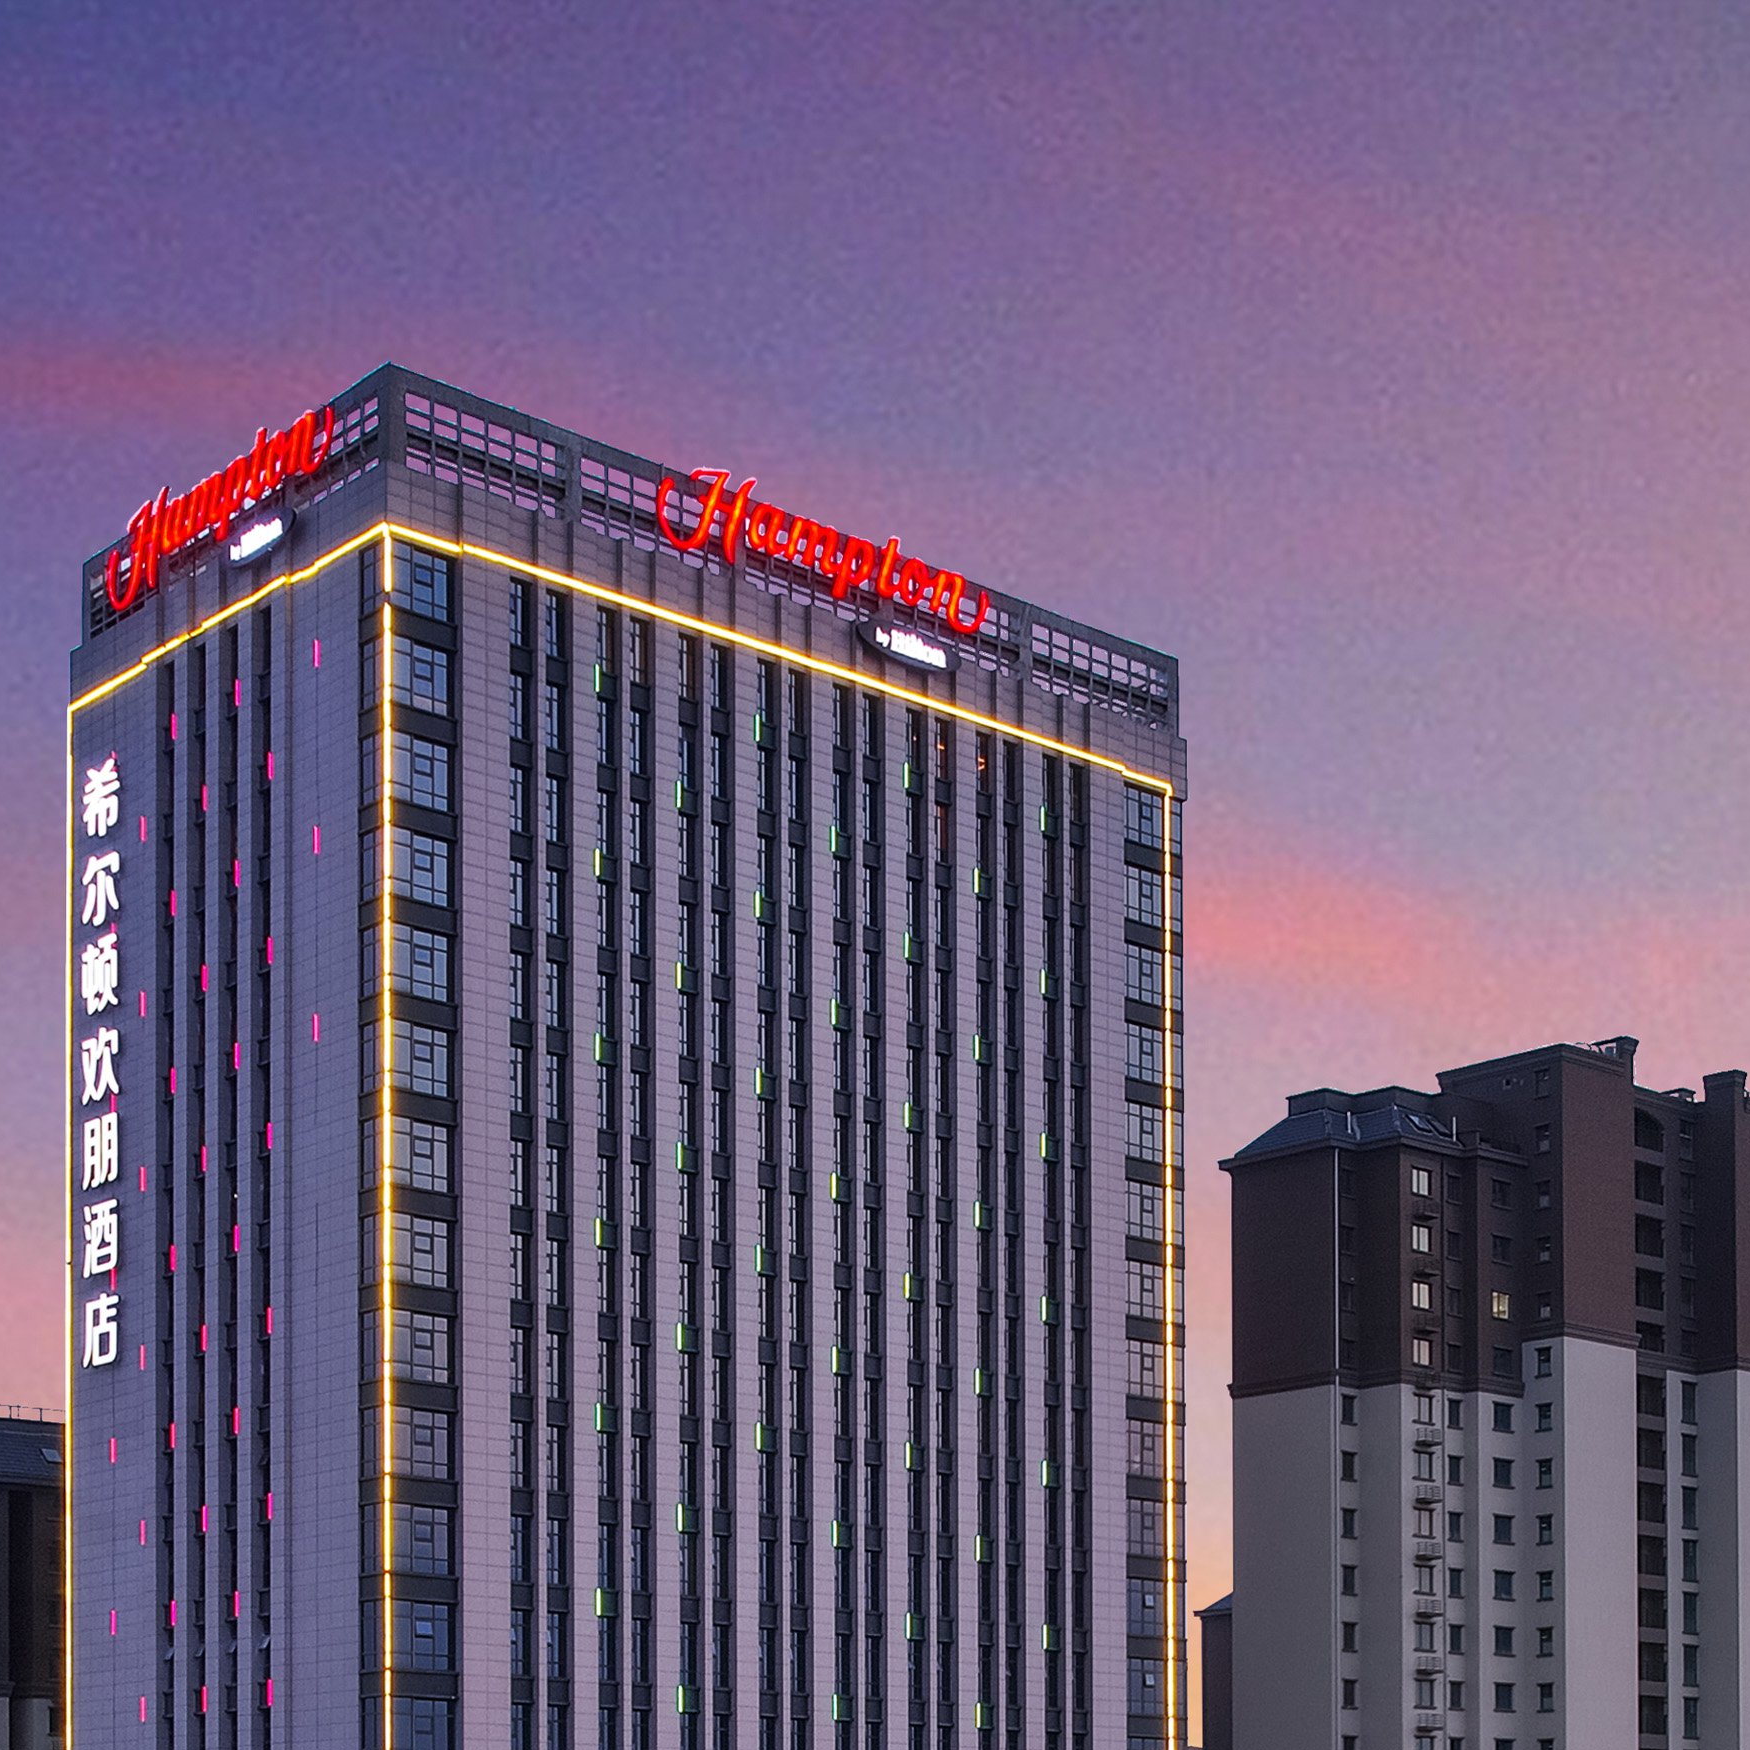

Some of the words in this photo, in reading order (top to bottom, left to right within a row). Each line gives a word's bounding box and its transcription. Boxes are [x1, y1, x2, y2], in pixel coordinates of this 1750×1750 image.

[107, 406, 335, 610] Hampton
[656, 465, 990, 634] Hampton
[81, 758, 120, 1368] 希尔顿欢朋酒店
